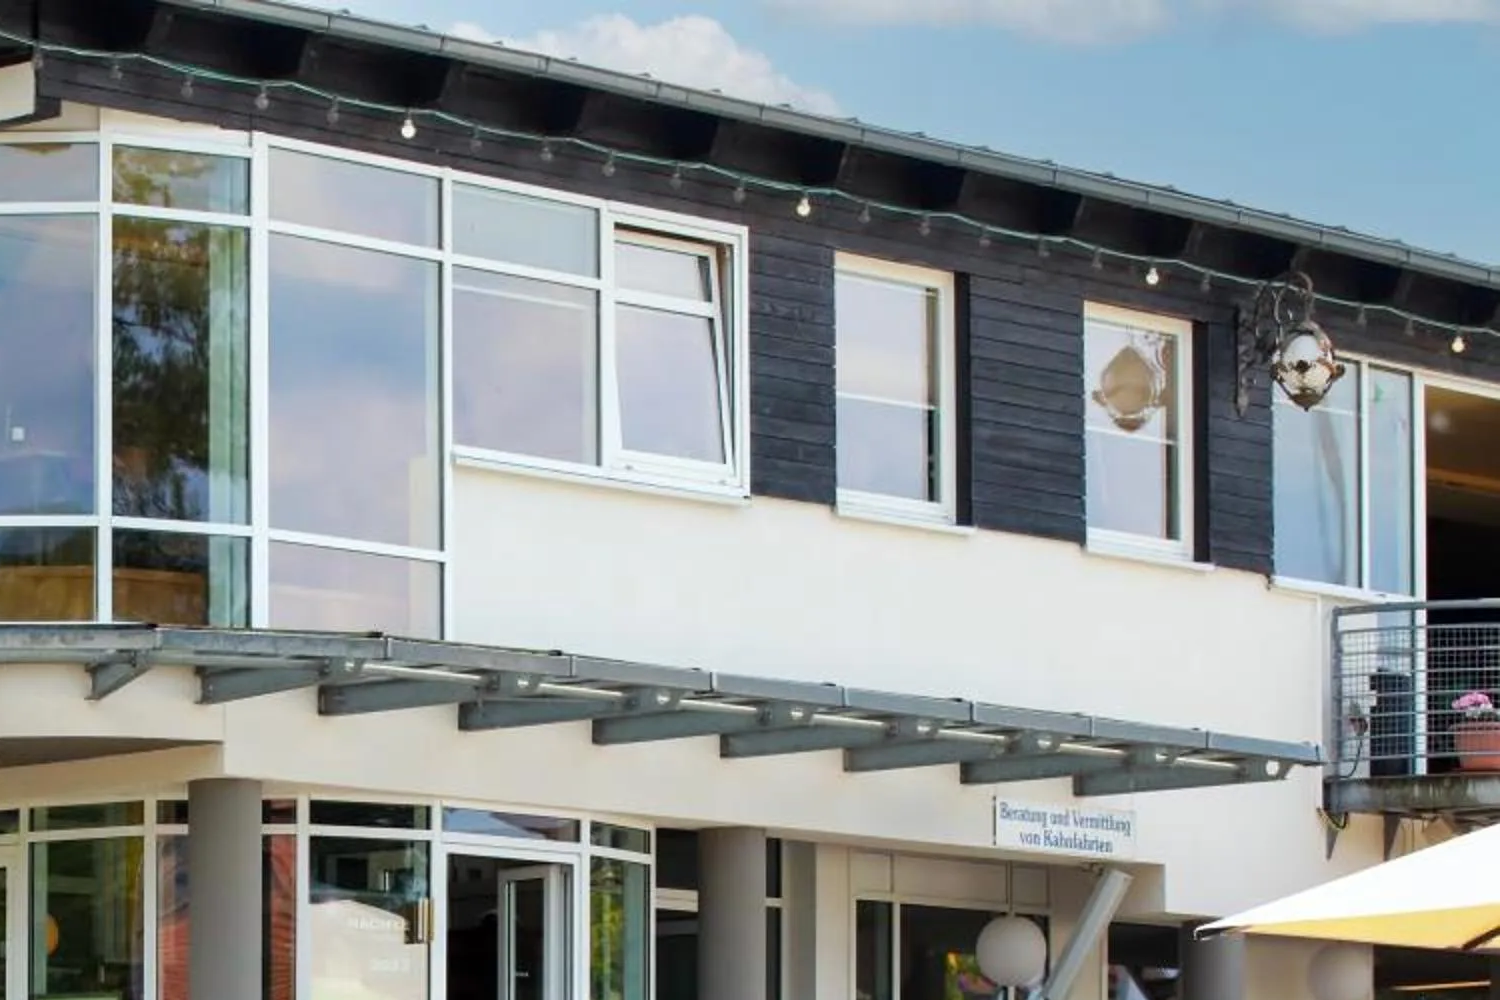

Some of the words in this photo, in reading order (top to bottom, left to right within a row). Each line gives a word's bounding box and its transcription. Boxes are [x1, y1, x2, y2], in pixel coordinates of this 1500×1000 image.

[1000, 801, 1048, 828] Beratung
[1050, 808, 1070, 827] und
[1072, 809, 1132, 837] Vermittlung
[1019, 831, 1042, 847] von
[1043, 830, 1114, 854] Kahnfahrten
